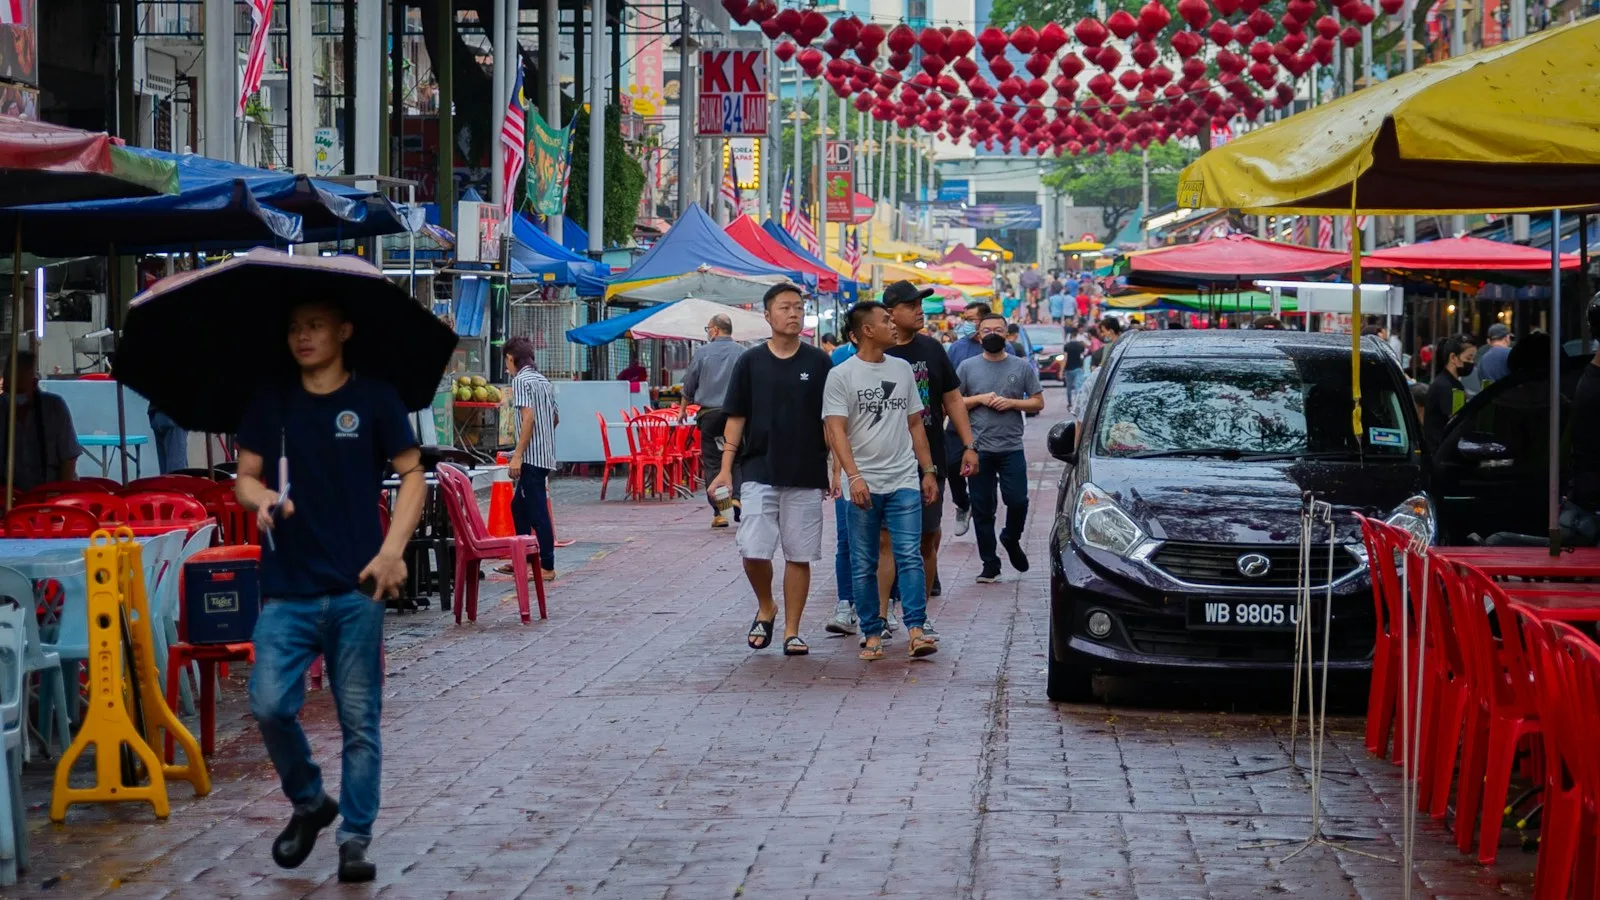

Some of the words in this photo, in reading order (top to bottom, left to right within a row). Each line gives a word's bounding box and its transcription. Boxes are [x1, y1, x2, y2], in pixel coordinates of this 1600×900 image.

[703, 51, 762, 92] KK
[700, 97, 721, 131] BUKA
[723, 95, 742, 133] 24
[743, 97, 766, 131] JAM
[826, 143, 851, 164] 4D
[857, 387, 886, 402] FOO
[859, 398, 907, 415] FIGHTERS
[1205, 602, 1230, 623] WB
[1236, 603, 1285, 624] 9805
[1289, 604, 1302, 624] U
